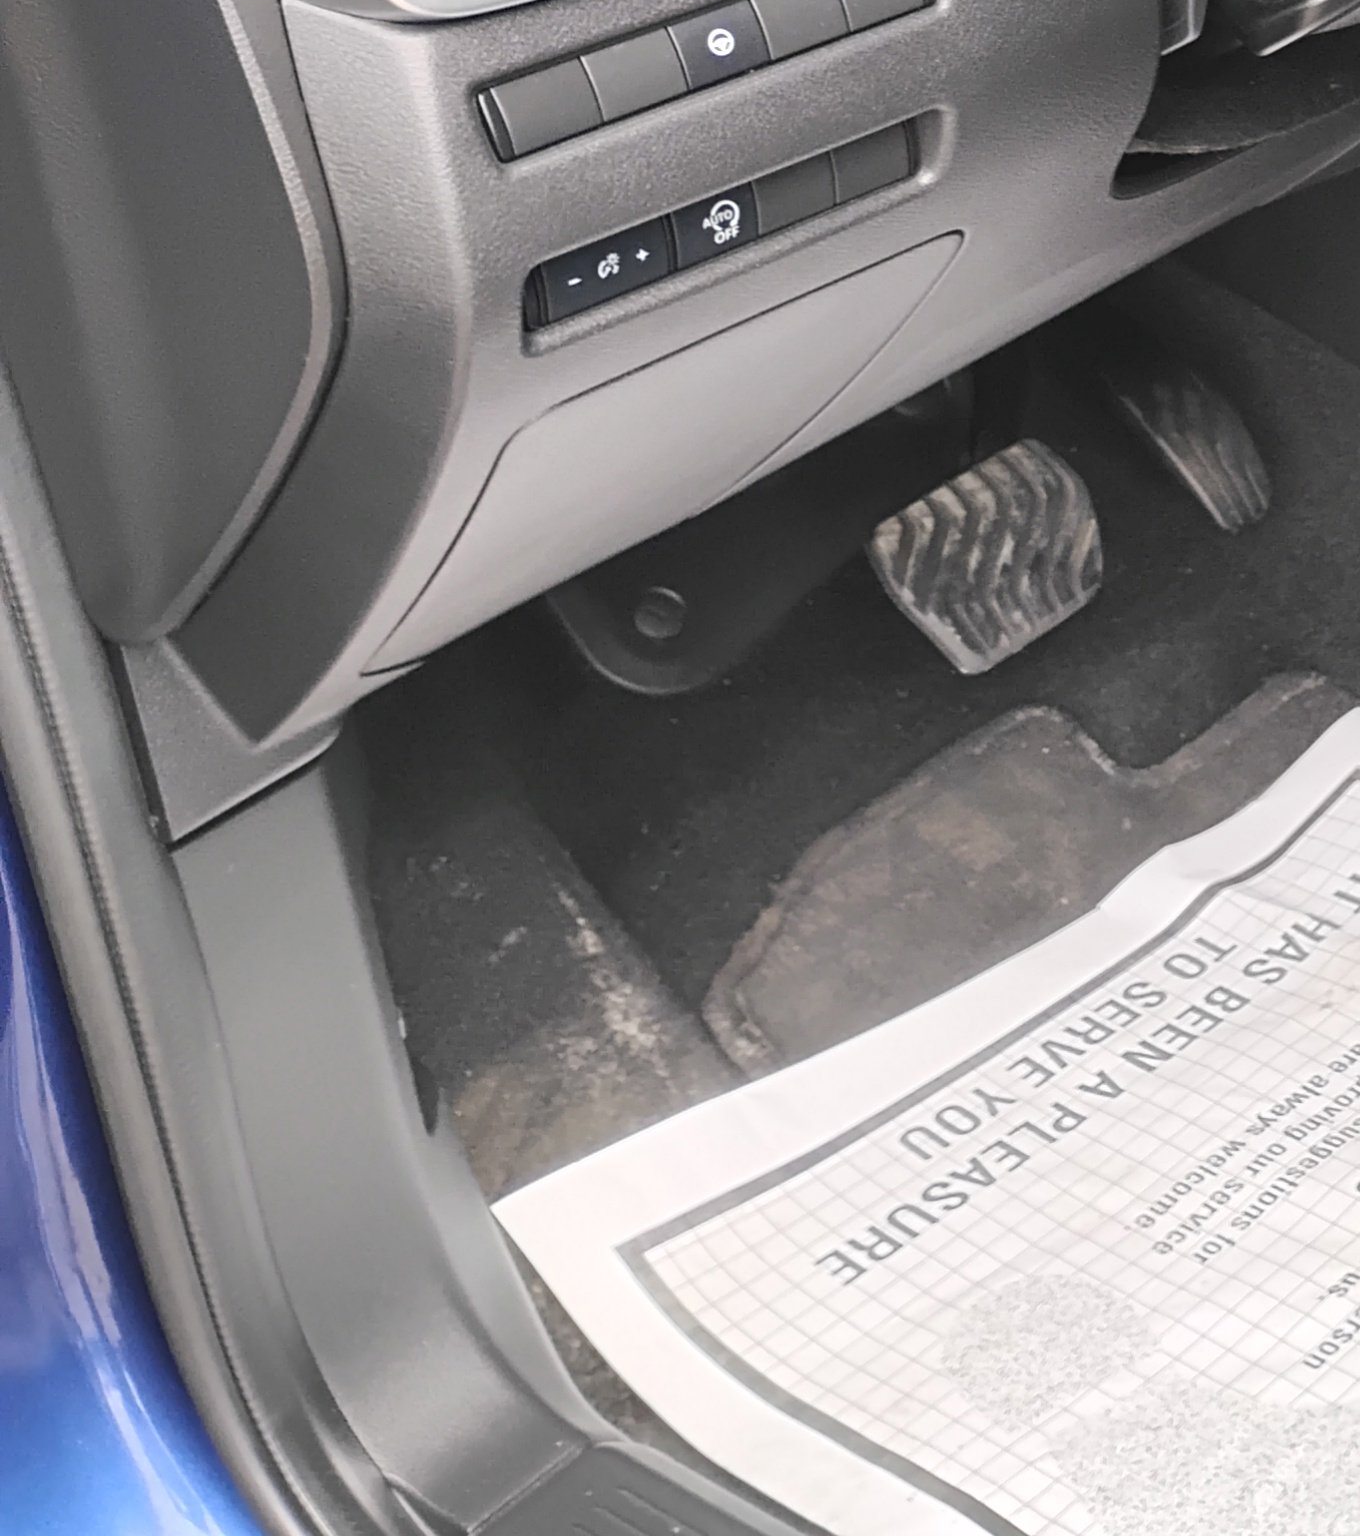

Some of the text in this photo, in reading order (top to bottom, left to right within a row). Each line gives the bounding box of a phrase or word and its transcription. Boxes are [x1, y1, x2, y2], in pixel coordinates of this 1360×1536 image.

[702, 208, 734, 231] AUTO
[714, 225, 741, 245] OFF
[1242, 912, 1343, 986] HAS
[898, 936, 1239, 1161] TO SERVE YOU
[1120, 984, 1252, 1074] BEEN
[1077, 1069, 1126, 1100] A
[1244, 1073, 1330, 1138] always
[813, 1100, 1089, 1287] PLEASURE
[1123, 1138, 1247, 1231] welcome.
[1244, 1141, 1288, 1178] our
[1151, 1176, 1246, 1256] service
[1191, 1233, 1236, 1266] for
